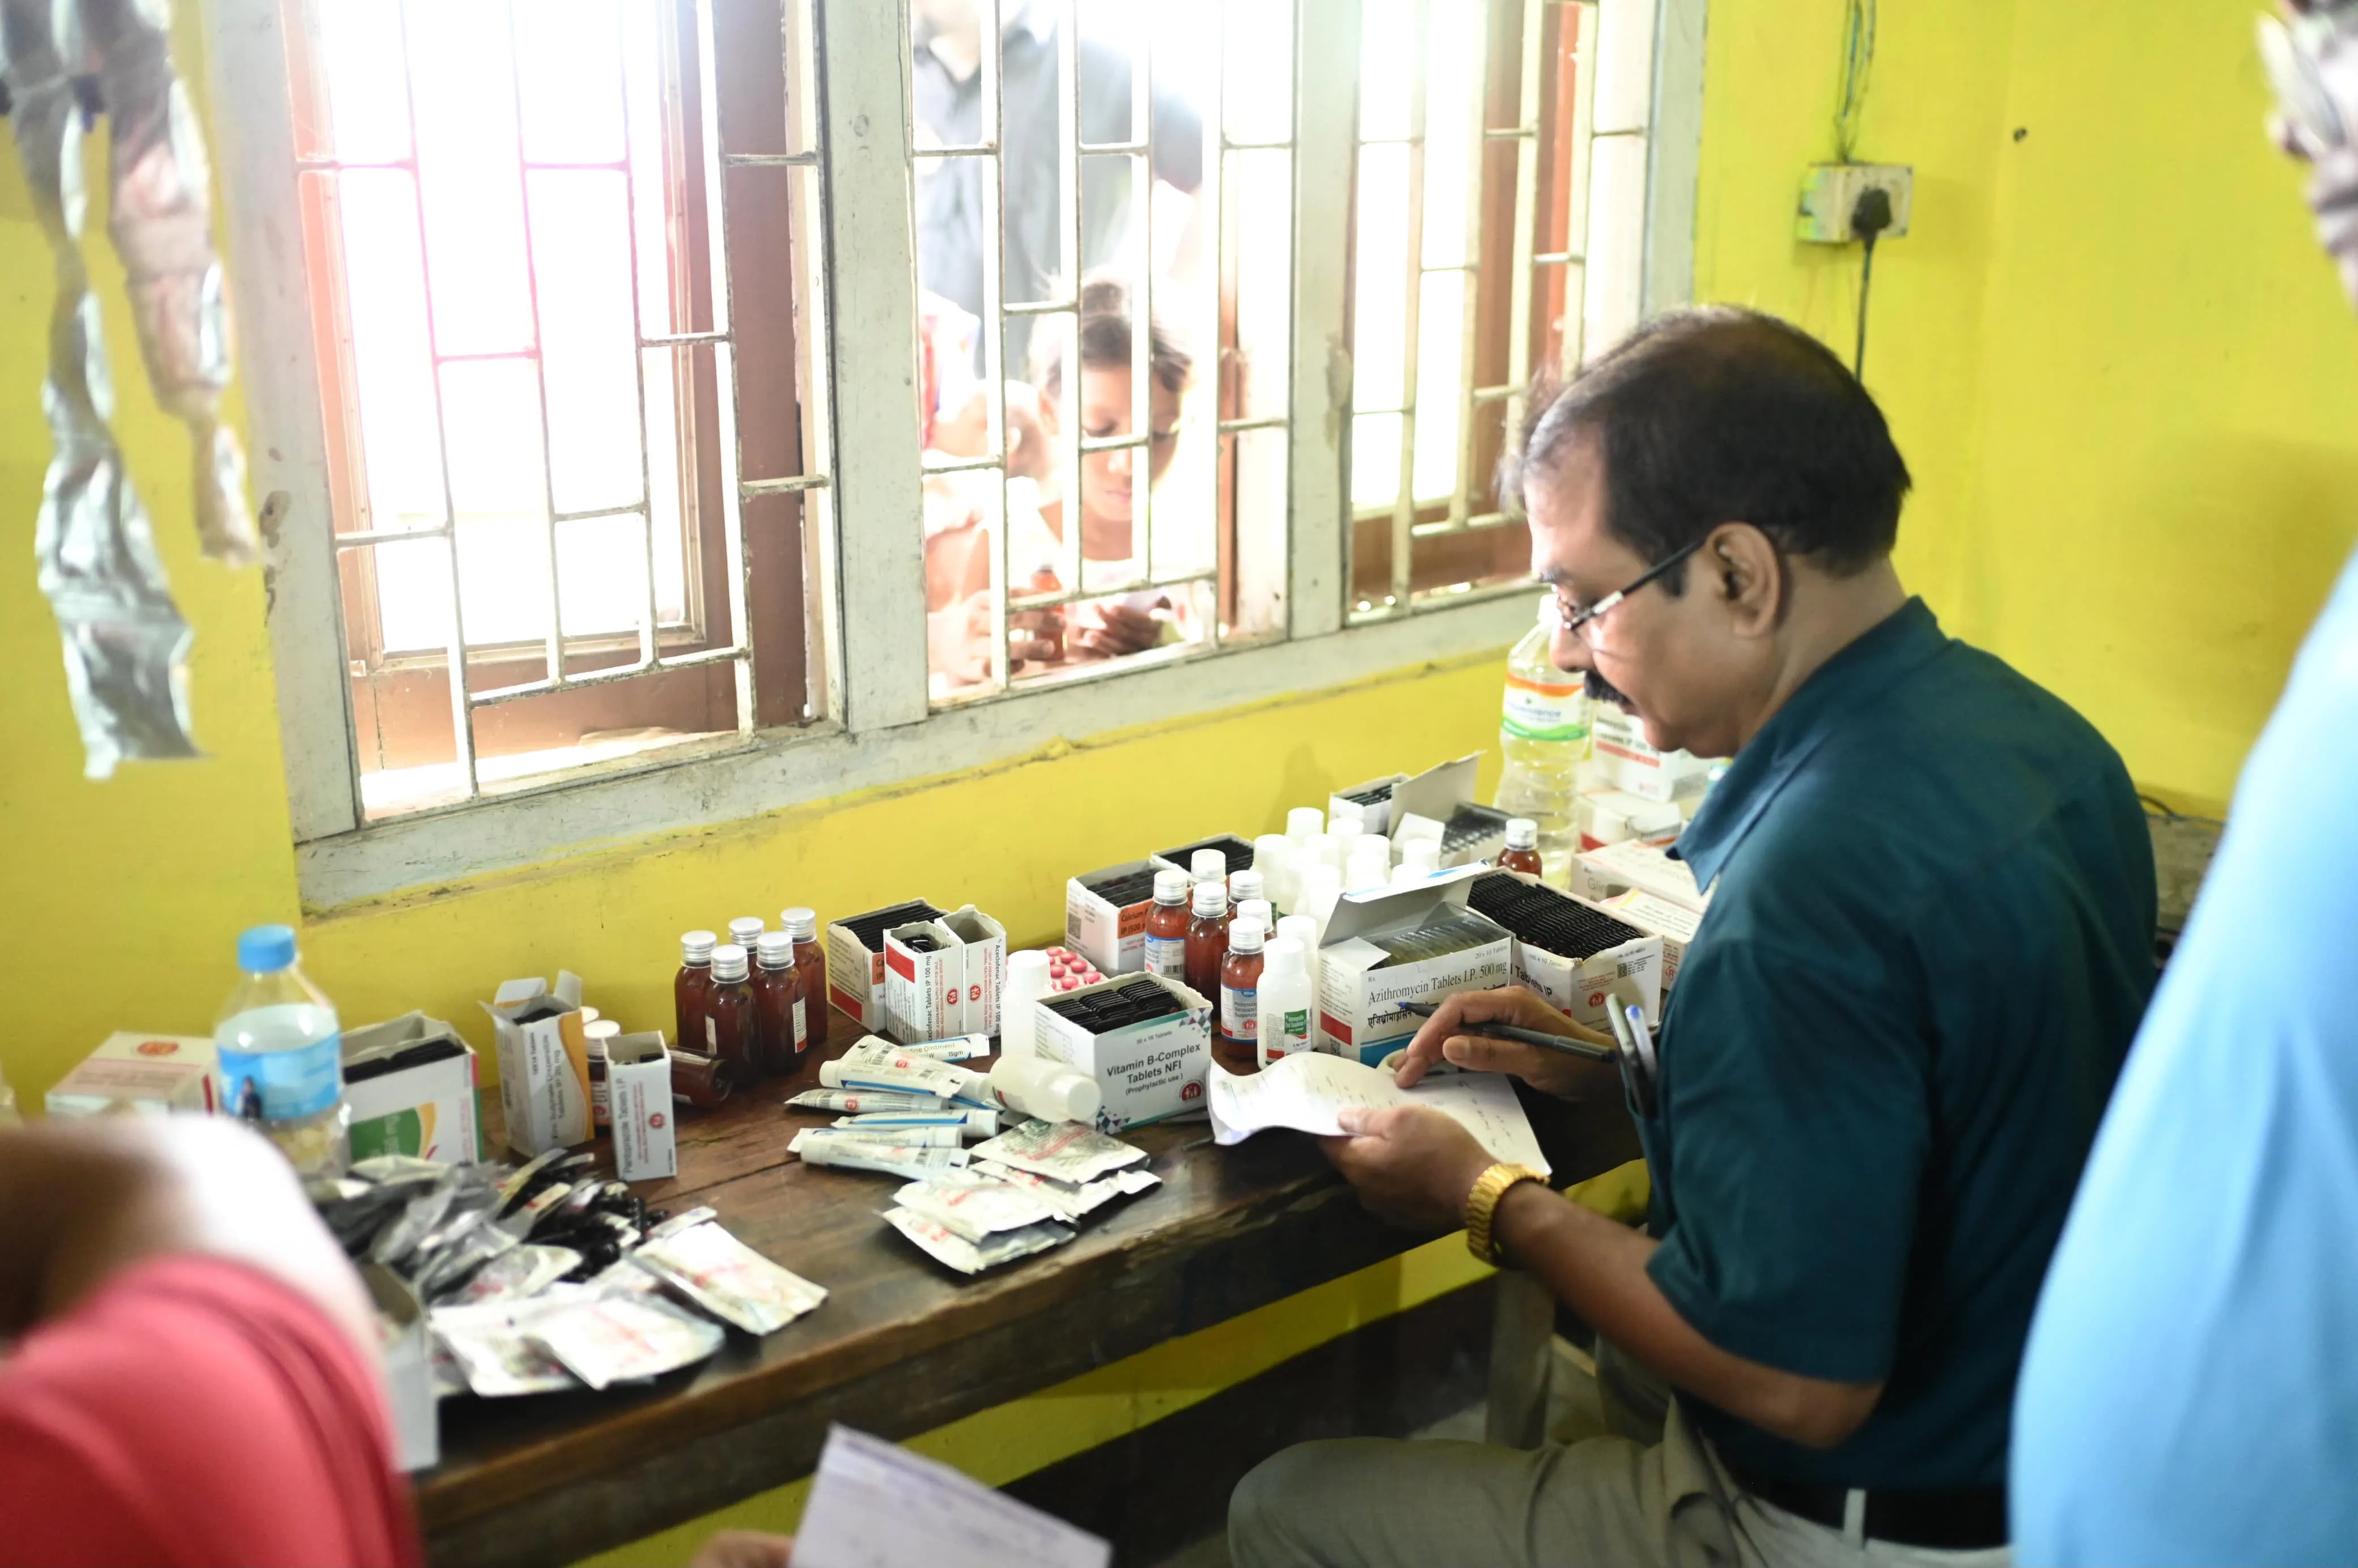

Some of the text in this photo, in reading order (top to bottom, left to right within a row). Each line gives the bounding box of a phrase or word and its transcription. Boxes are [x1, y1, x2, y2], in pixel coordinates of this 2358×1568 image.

[1121, 911, 1143, 923] Calcium
[1121, 926, 1127, 934] IP
[926, 955, 932, 964] mg
[1368, 980, 1428, 1005] Azithromycin
[1431, 972, 1461, 990] Tablets
[1464, 968, 1477, 983] I.P.
[1480, 962, 1494, 979] 500
[1495, 962, 1507, 974] mg
[1515, 965, 1543, 993] Tablets
[1545, 986, 1552, 997] IP
[994, 1023, 1000, 1033] mg
[924, 1043, 955, 1052] Ointment
[1107, 1043, 1201, 1077] Vitamin B-Complex
[1127, 1060, 1181, 1083] Tablets NFI
[1126, 1078, 1167, 1096] (Prophylactic
